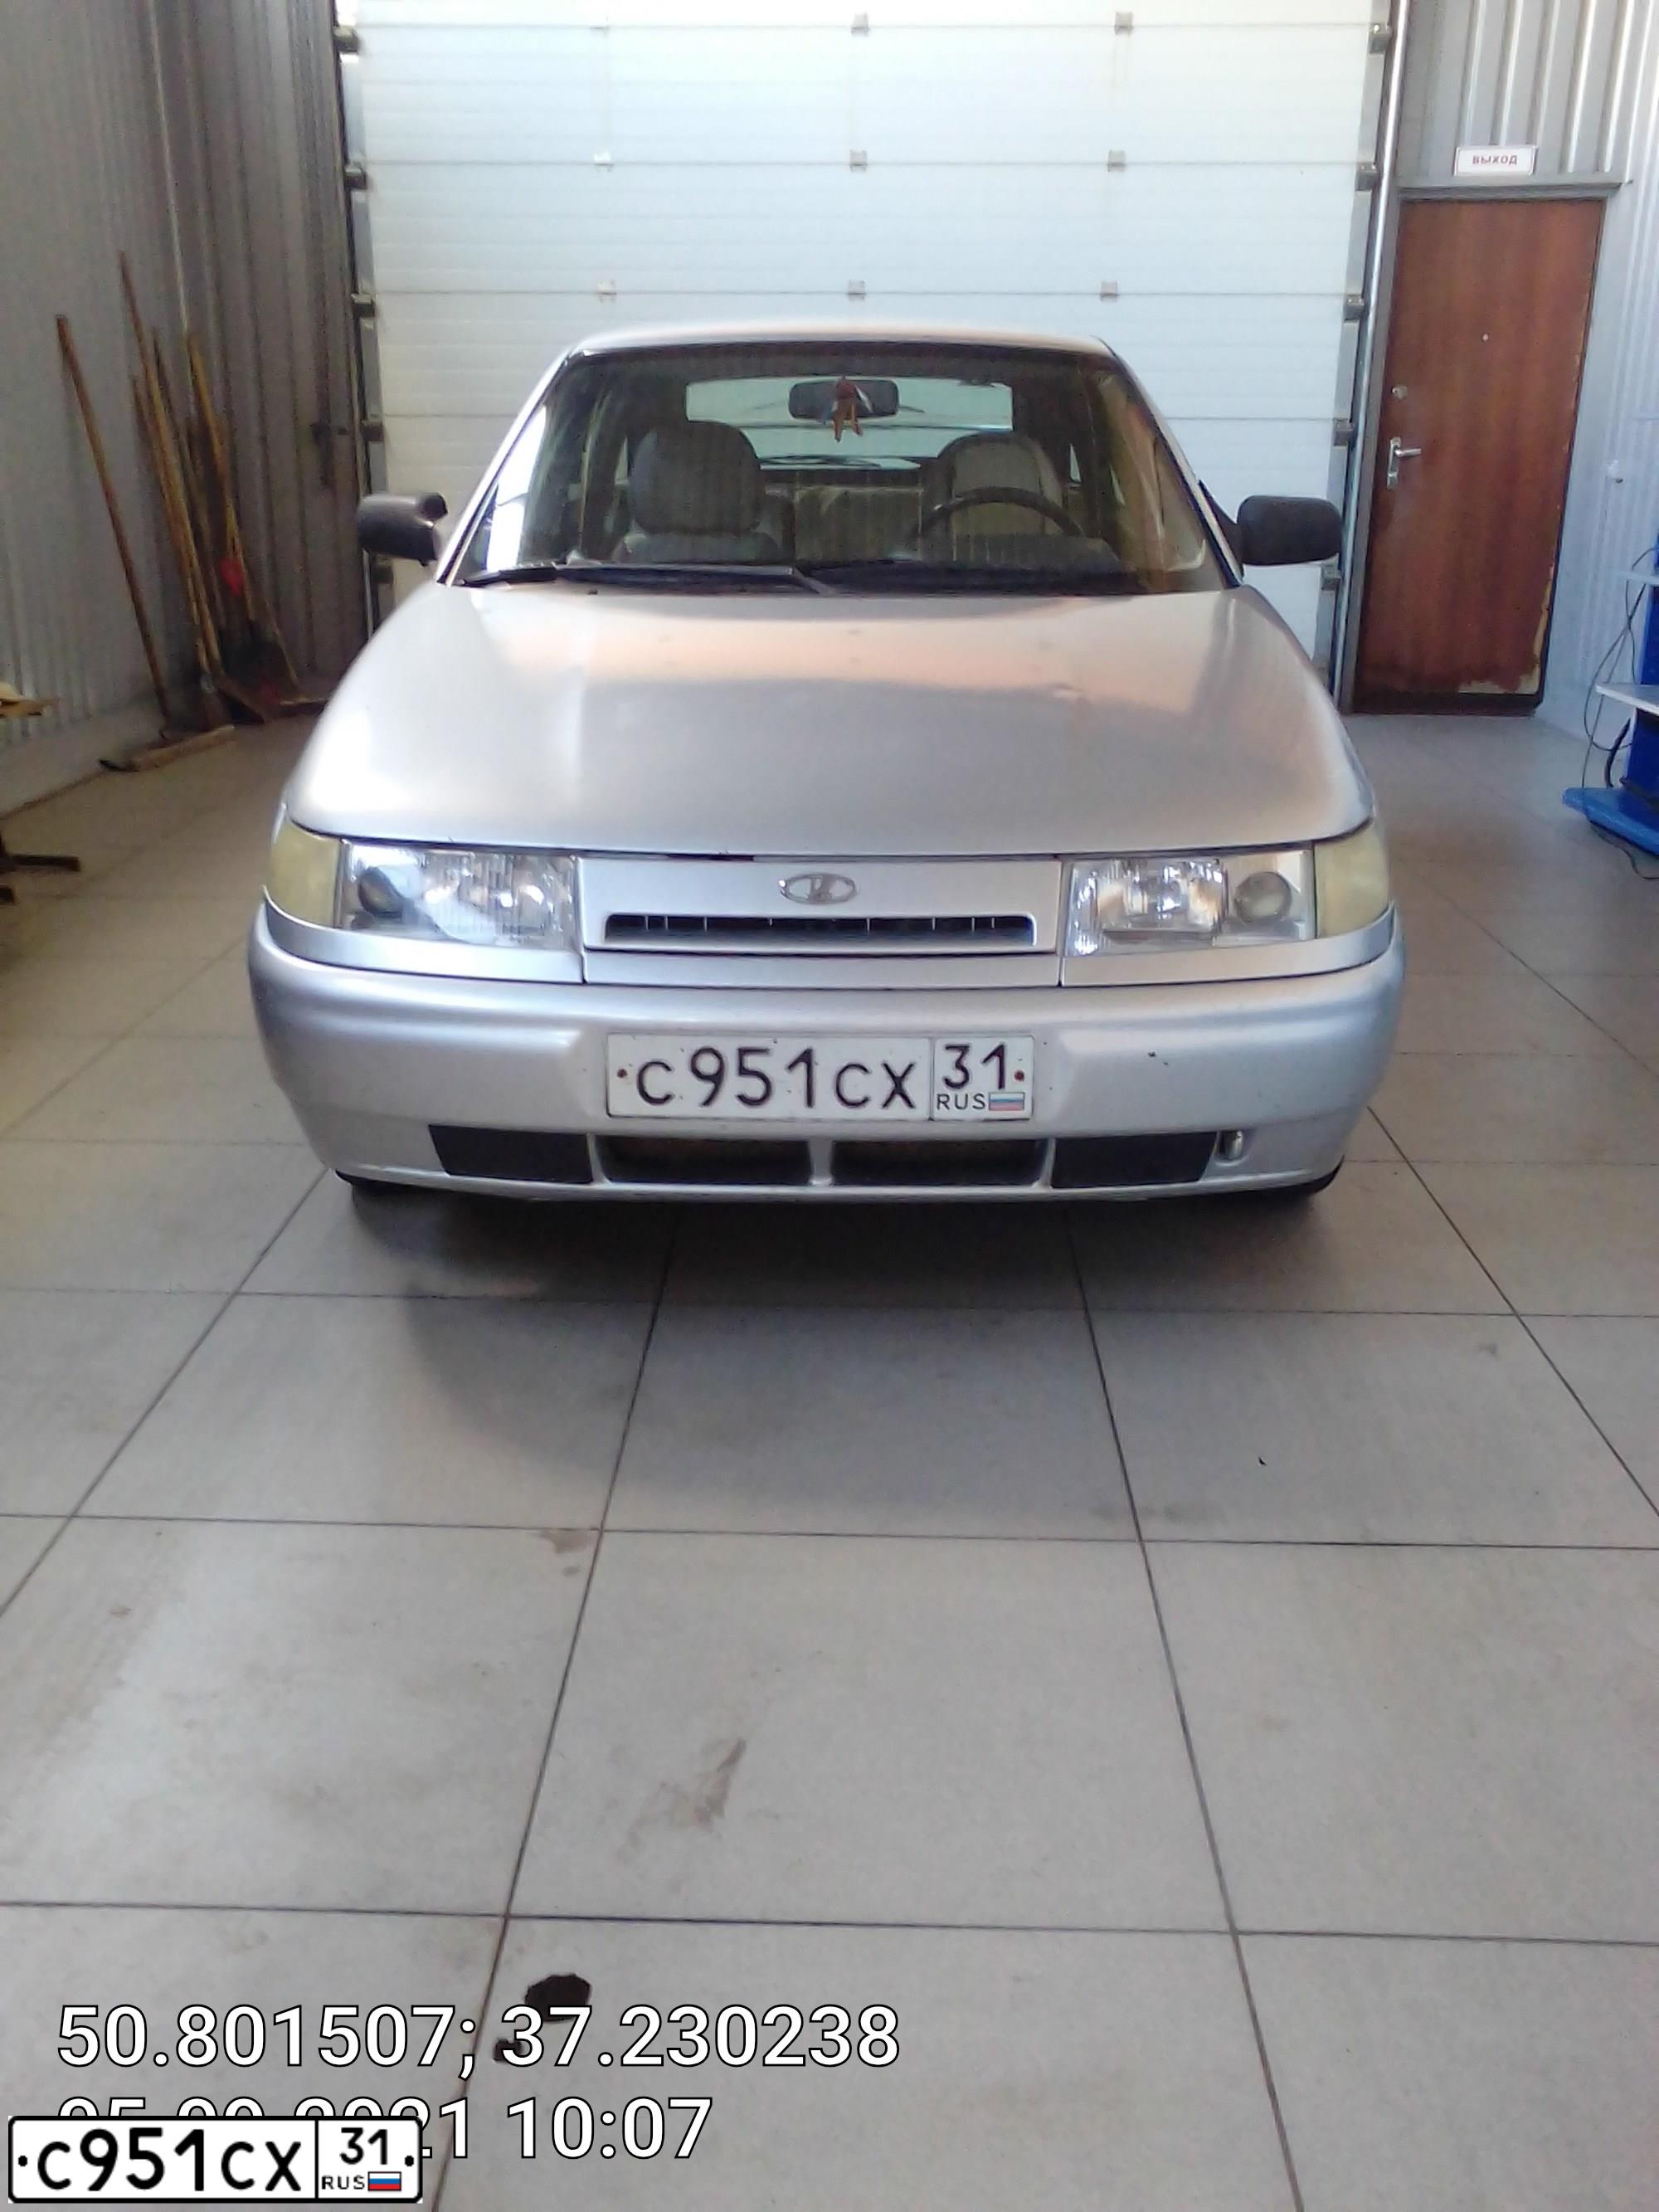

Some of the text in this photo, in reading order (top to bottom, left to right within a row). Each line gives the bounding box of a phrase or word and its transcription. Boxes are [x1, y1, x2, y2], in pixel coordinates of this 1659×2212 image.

[1472, 154, 1517, 165] ВЫХОД
[943, 1043, 1005, 1090] 31
[937, 1093, 985, 1110] RUS
